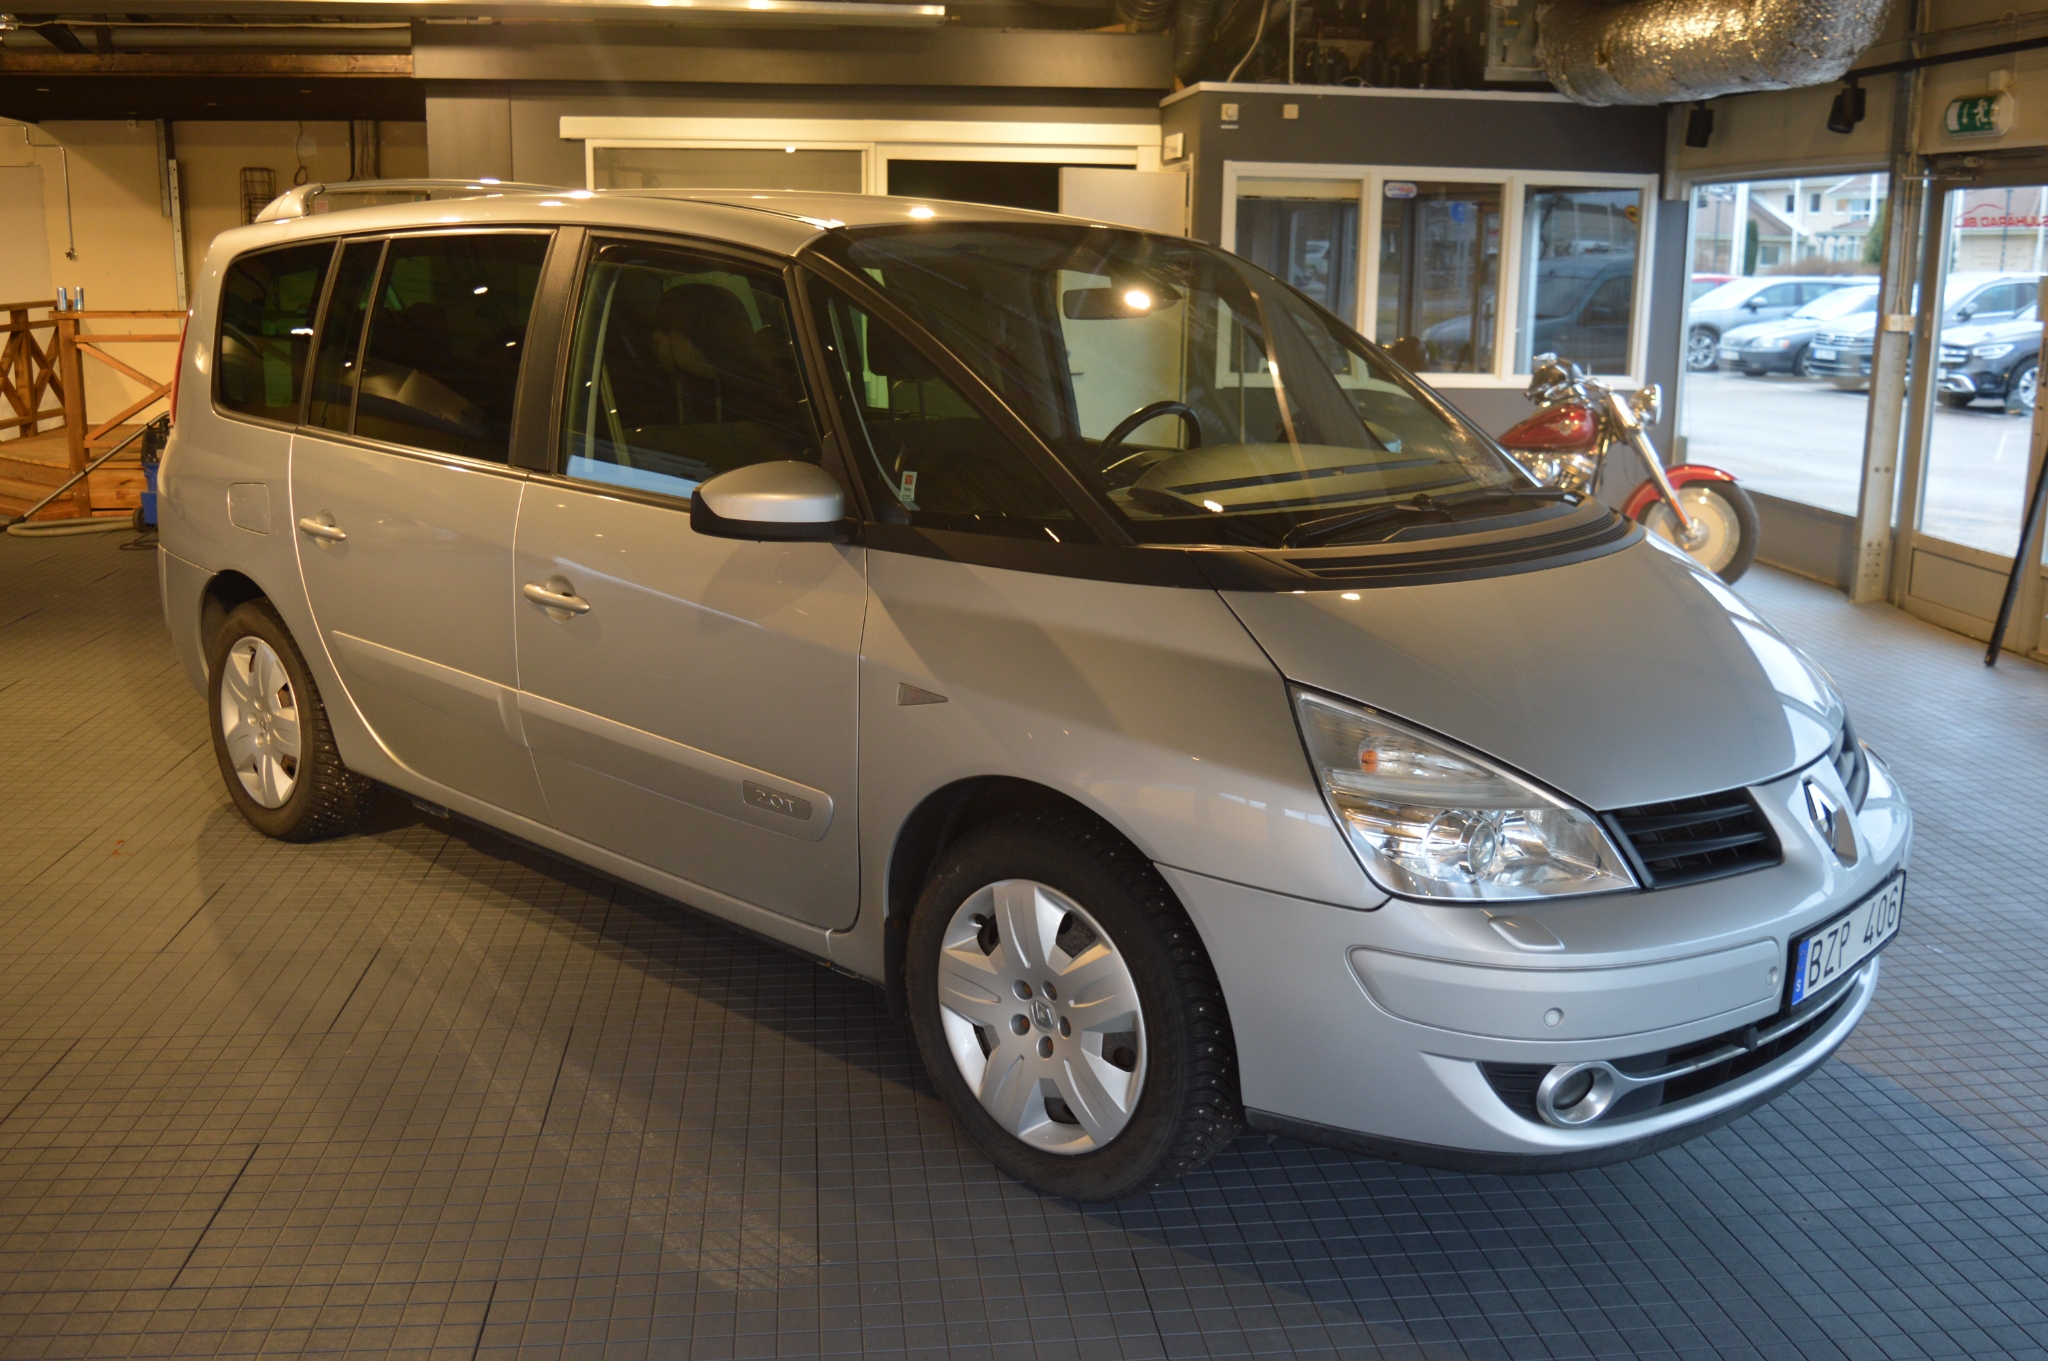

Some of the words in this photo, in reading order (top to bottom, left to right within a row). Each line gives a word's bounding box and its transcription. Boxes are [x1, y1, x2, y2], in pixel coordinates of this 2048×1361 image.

[756, 789, 794, 812] 2.0T
[1808, 921, 1850, 989] BZP
[1863, 885, 1898, 945] 406
[1795, 979, 1802, 992] S
